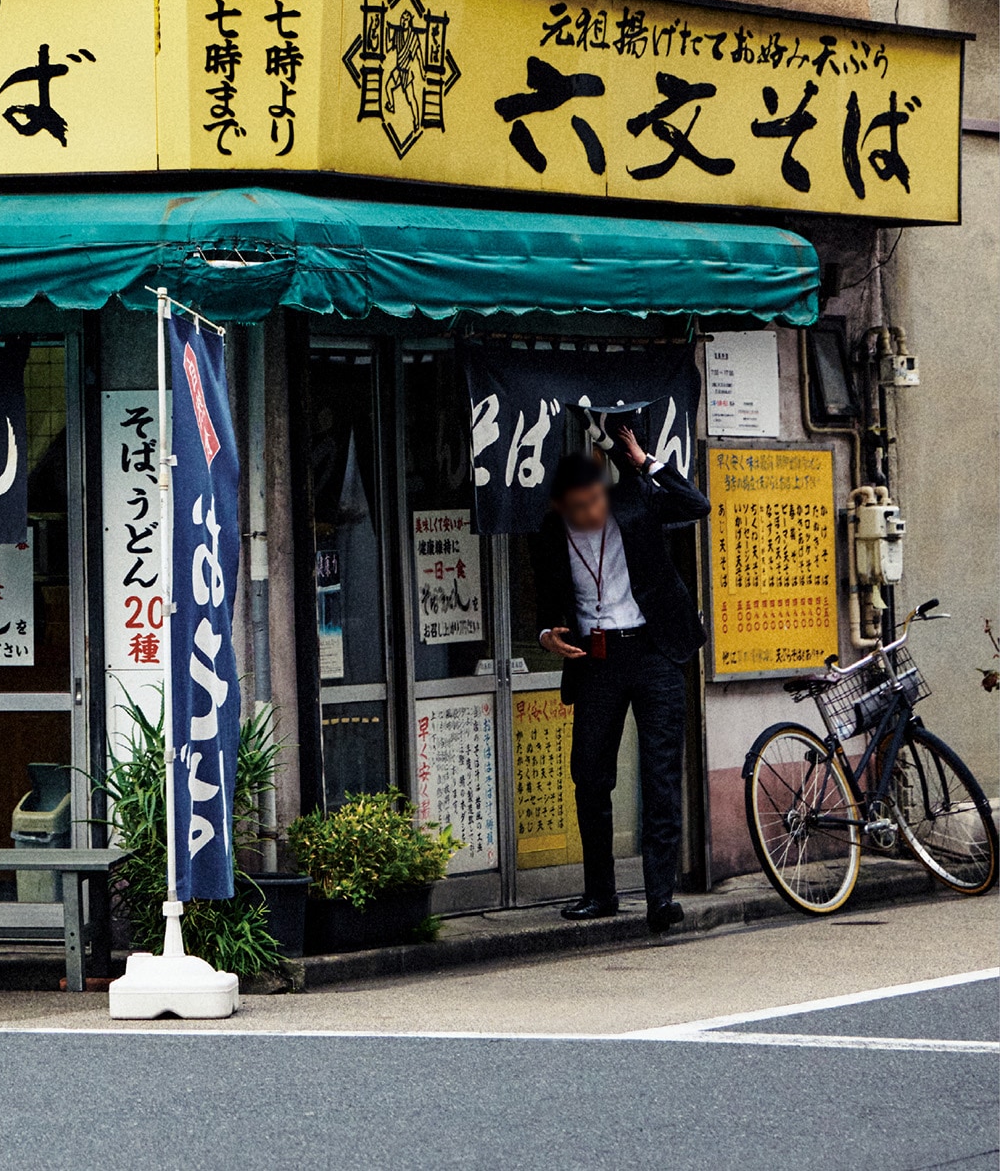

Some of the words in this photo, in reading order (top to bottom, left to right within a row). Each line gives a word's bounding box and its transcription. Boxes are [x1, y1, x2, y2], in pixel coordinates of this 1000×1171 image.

[540, 3, 889, 77] 元祖揚げたてお好み天ぷら
[494, 56, 922, 200] 六文そば
[423, 558, 466, 580] 一日一食
[124, 595, 163, 629] 20
[128, 632, 161, 663] 種
